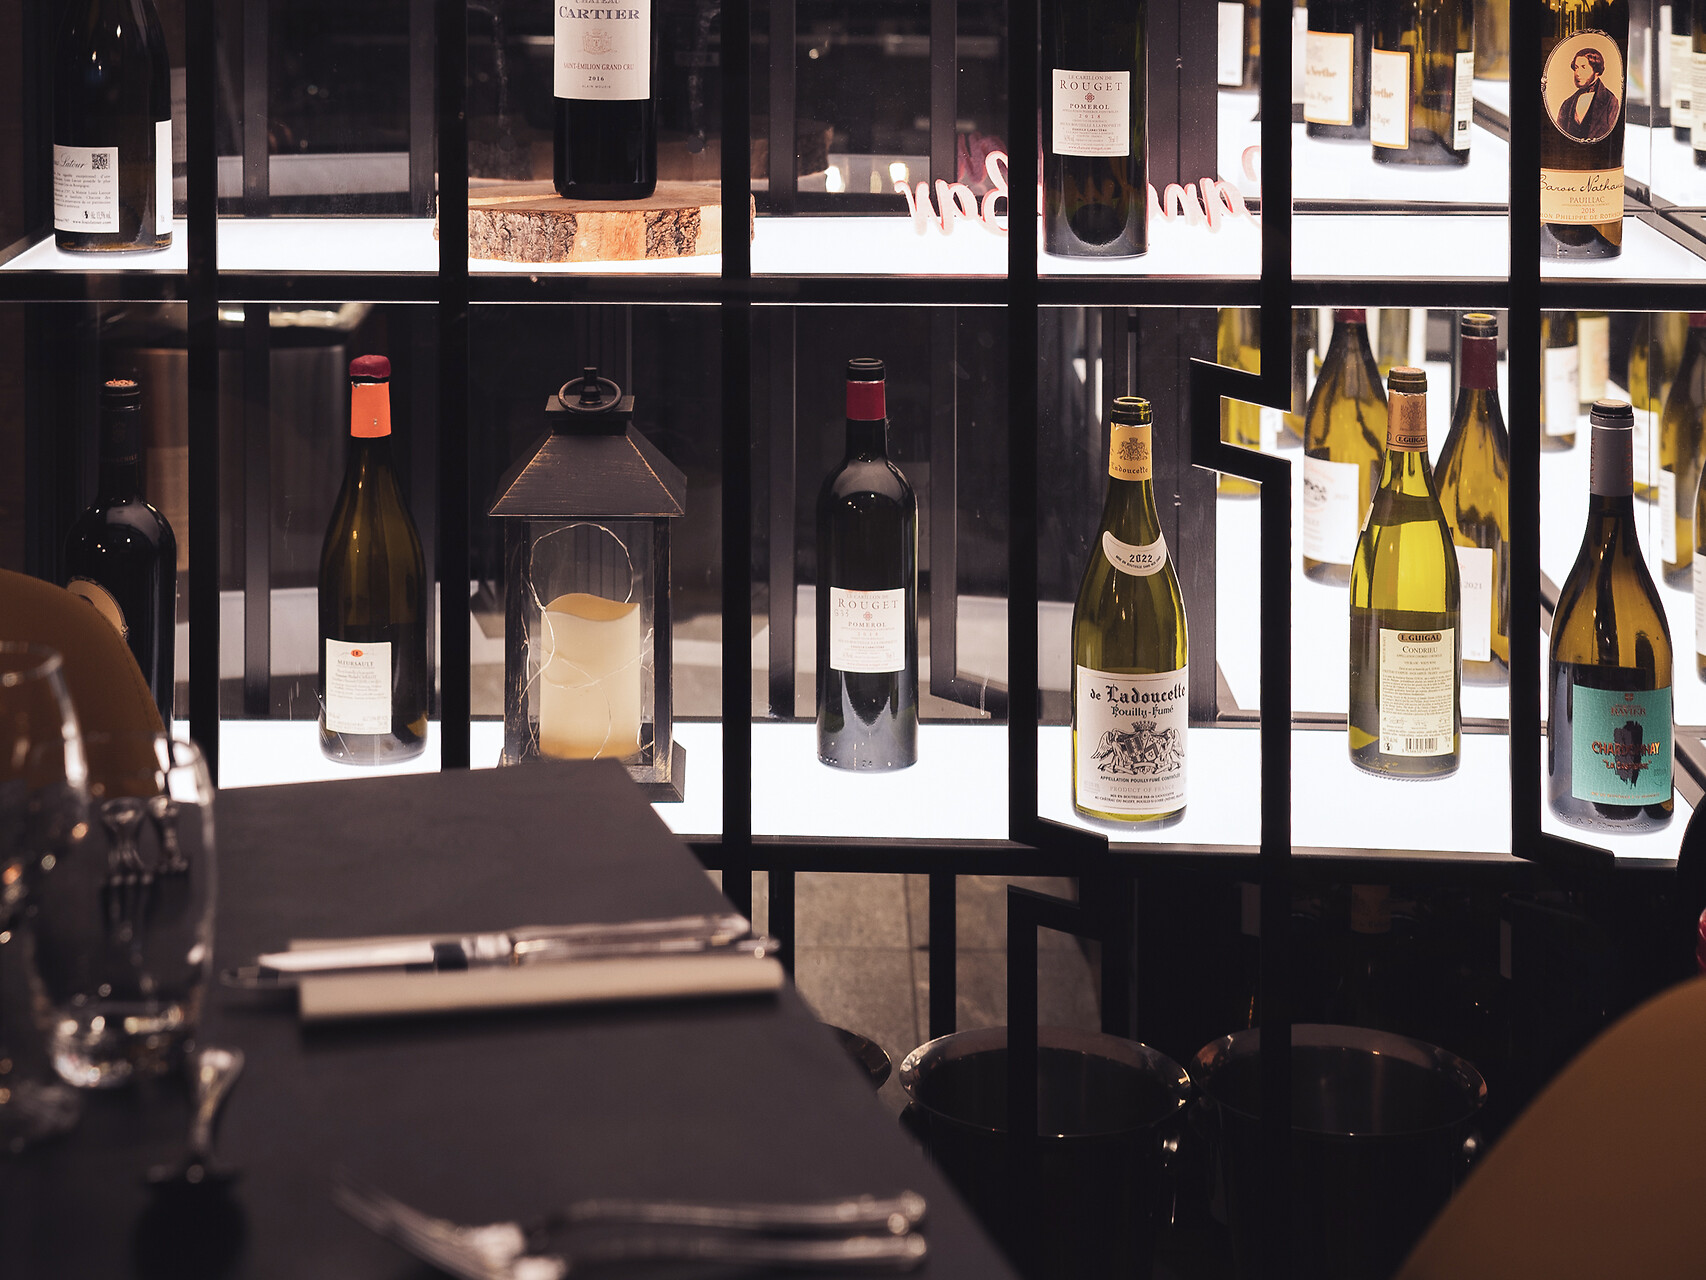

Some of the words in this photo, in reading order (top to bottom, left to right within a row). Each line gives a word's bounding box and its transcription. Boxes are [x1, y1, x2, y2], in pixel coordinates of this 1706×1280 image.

[559, 5, 640, 20] CARTIER
[1060, 79, 1122, 91] ROUGET
[1569, 196, 1605, 204] PAUILLAC
[1129, 554, 1153, 563] 2022
[837, 598, 899, 610] ROUGET
[1402, 645, 1438, 654] CONDRIEU
[1090, 688, 1101, 701] de
[1105, 683, 1186, 704] Ladoucette
[1111, 704, 1174, 719] Pouilly-Fumé
[1611, 707, 1647, 717] RAVIER
[1591, 741, 1661, 757] CHARDONNAY
[1100, 775, 1130, 783] APPELLATION
